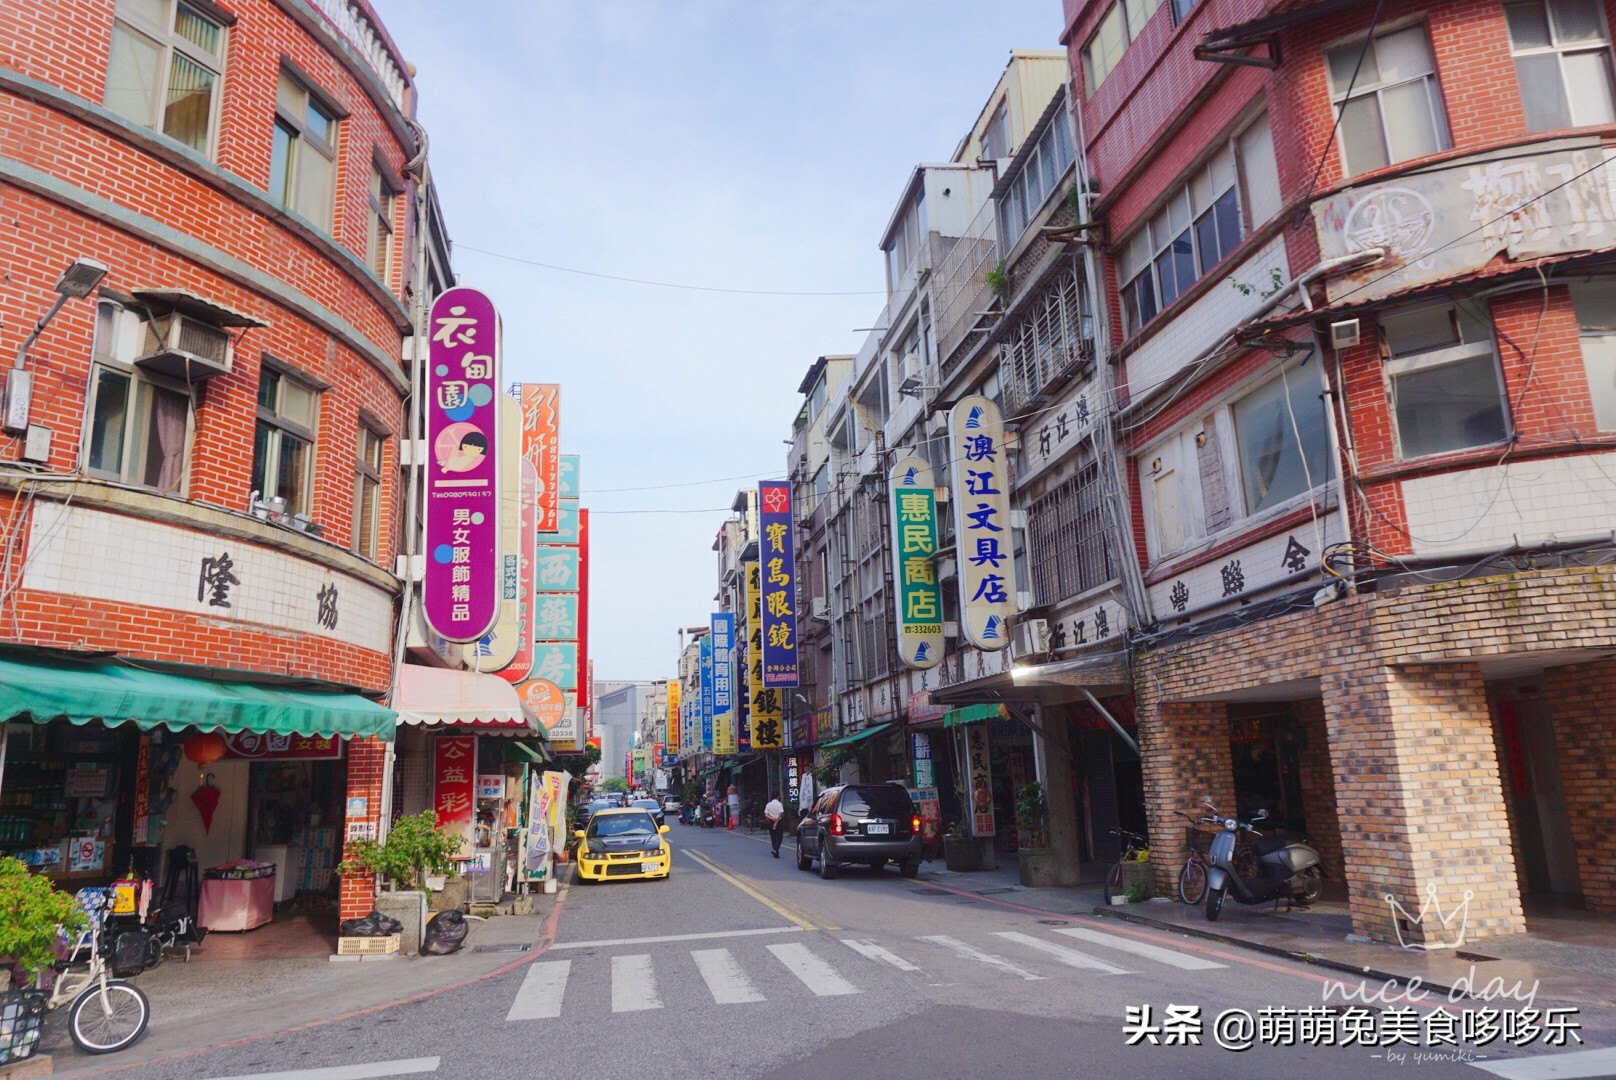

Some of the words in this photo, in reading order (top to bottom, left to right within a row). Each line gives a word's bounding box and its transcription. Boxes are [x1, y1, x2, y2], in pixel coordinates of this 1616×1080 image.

[433, 306, 493, 409] 衣甸園
[452, 508, 471, 622] 男女服飾精品
[505, 556, 516, 599] 各式冰沙
[900, 493, 937, 619] 惠民商店
[963, 436, 1008, 604] 澳江文具店
[765, 522, 794, 650] 寶島眼鏡
